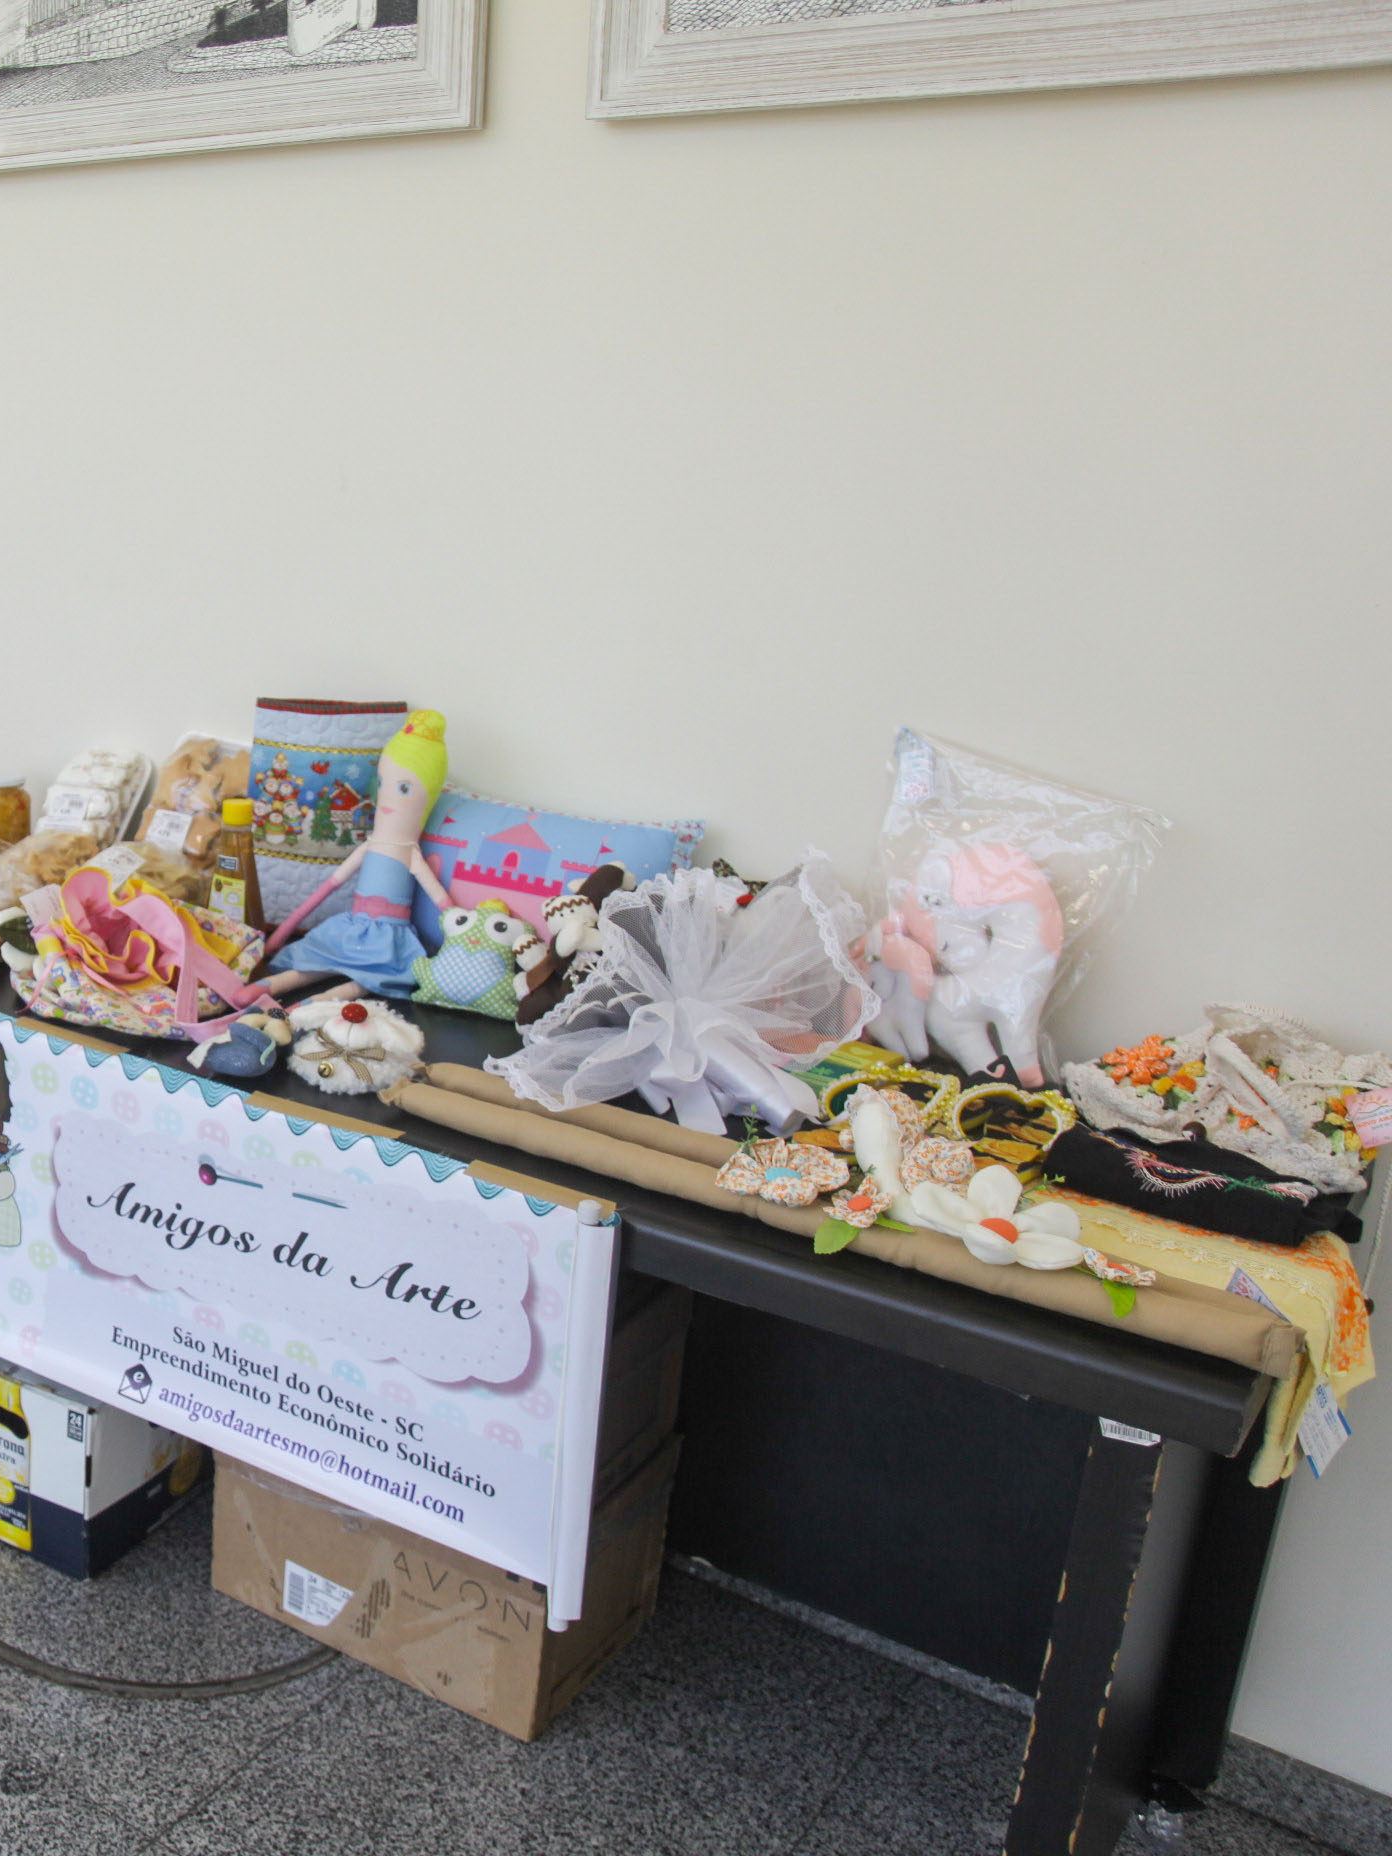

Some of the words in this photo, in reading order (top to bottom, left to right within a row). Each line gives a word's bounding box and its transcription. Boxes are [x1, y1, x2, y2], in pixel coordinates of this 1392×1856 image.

[86, 1182, 262, 1253] Amigos
[272, 1231, 334, 1277] da
[350, 1262, 483, 1320] Arte
[69, 1412, 83, 1427] 24
[111, 1325, 271, 1406] Empreendimento
[277, 1392, 389, 1453] Econômico
[396, 1442, 496, 1498] Solidário
[172, 1326, 206, 1353] São
[212, 1341, 280, 1384] Miguel
[285, 1372, 311, 1395] do
[317, 1384, 375, 1422] Oeste
[395, 1415, 424, 1443] SC
[158, 1387, 465, 1524] amigosdaartesmo@hotmail.com
